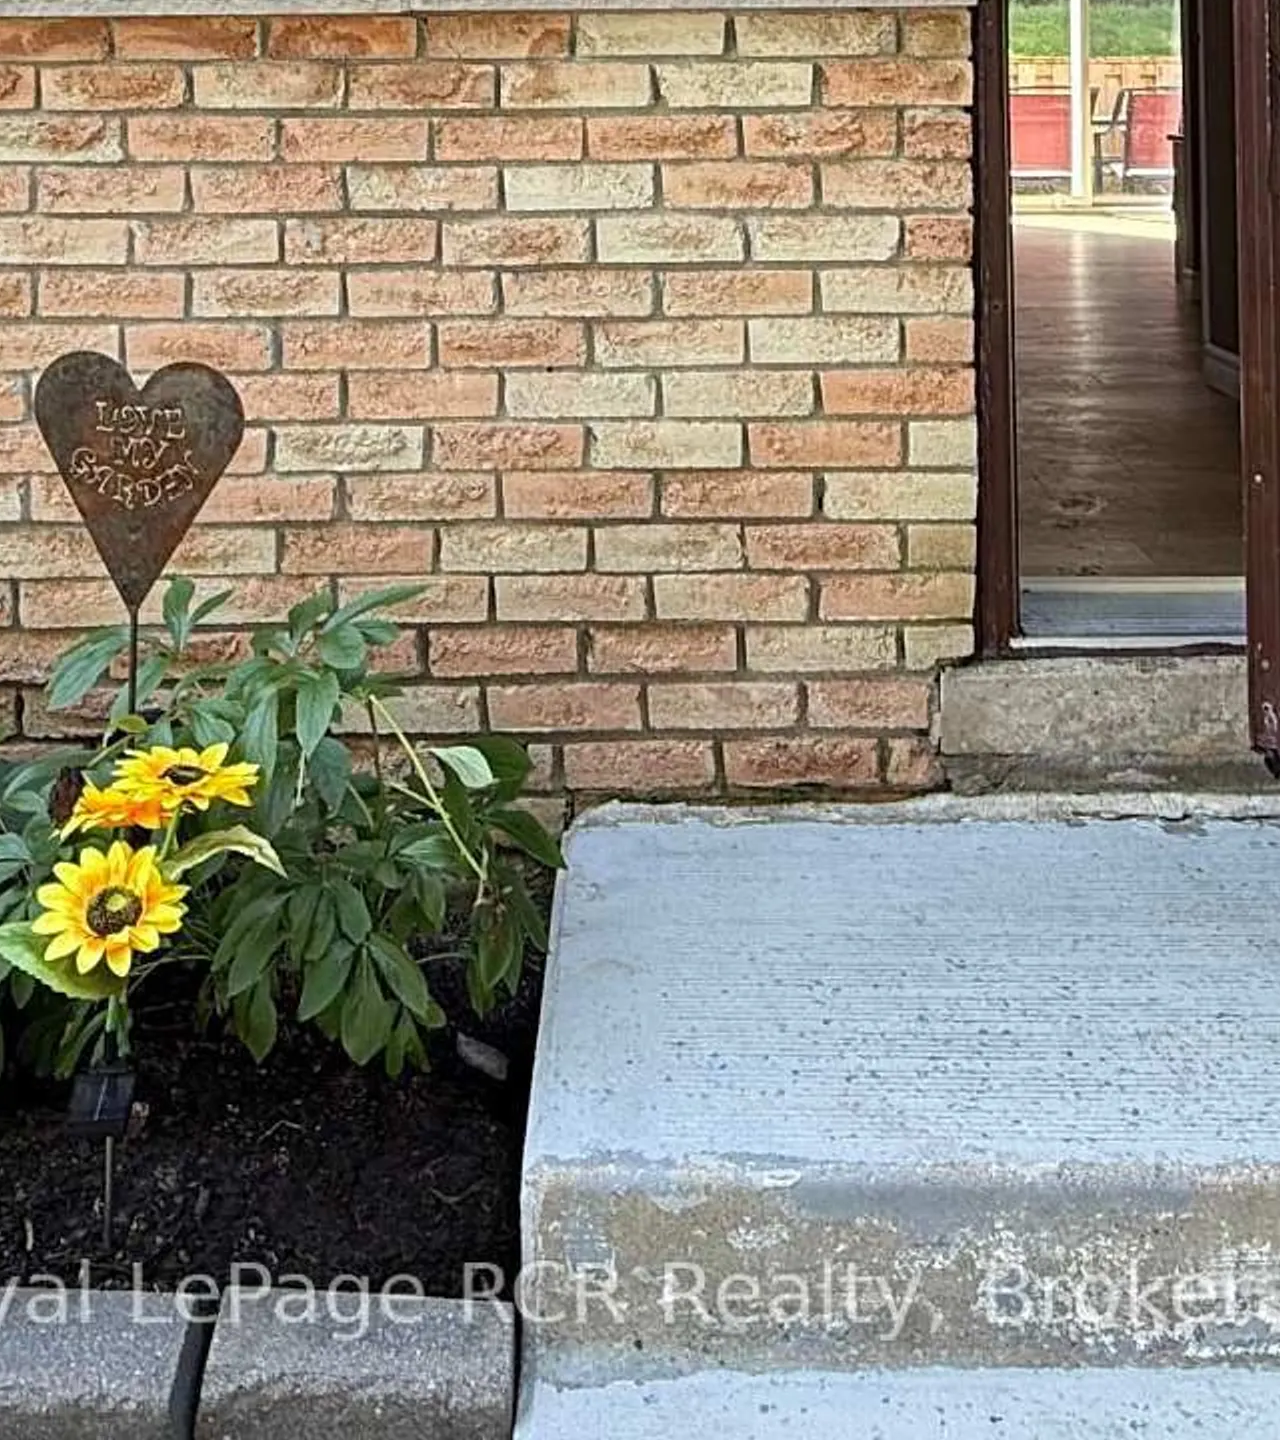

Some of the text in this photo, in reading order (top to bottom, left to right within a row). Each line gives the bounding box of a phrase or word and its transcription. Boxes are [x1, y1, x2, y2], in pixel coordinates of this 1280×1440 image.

[96, 401, 185, 439] LOVE
[111, 436, 169, 469] MY
[69, 447, 199, 509] GARDEN
